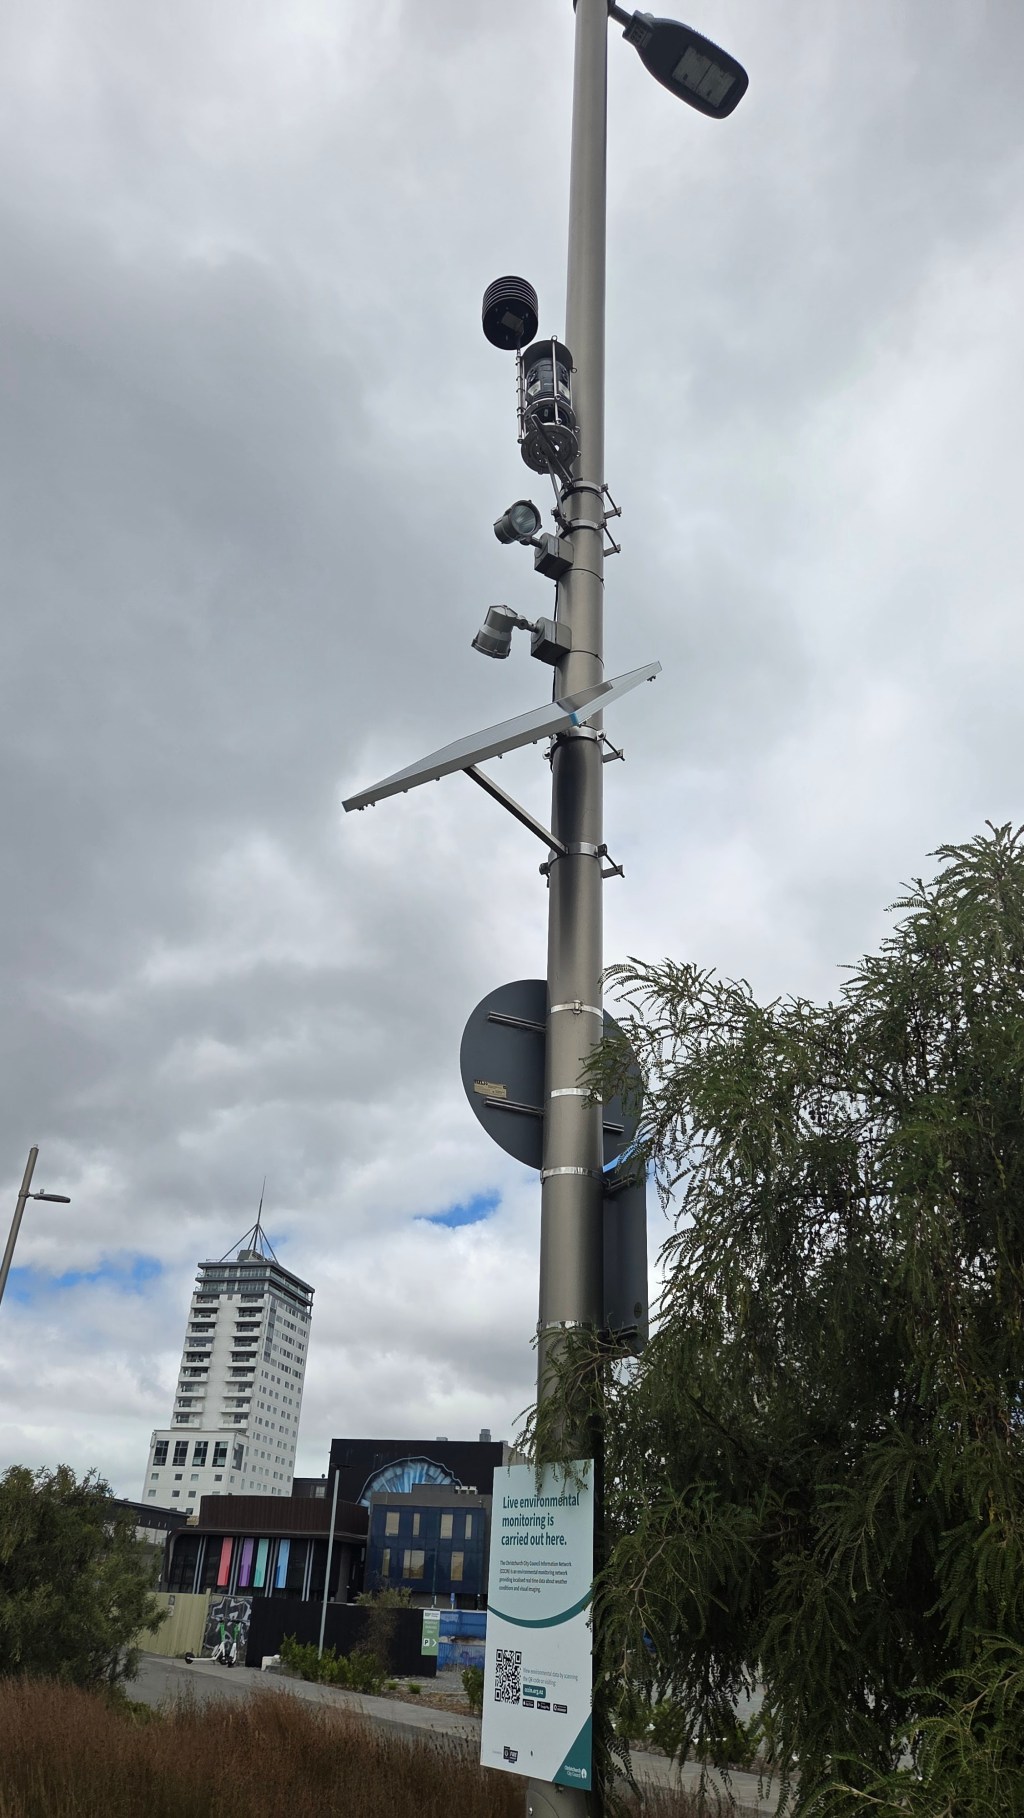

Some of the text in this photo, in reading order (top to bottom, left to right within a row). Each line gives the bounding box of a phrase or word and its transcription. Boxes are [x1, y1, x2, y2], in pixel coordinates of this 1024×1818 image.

[503, 1493, 580, 1509] Live environmental
[502, 1512, 554, 1530] monitoring is
[501, 1532, 567, 1546] carried out here.
